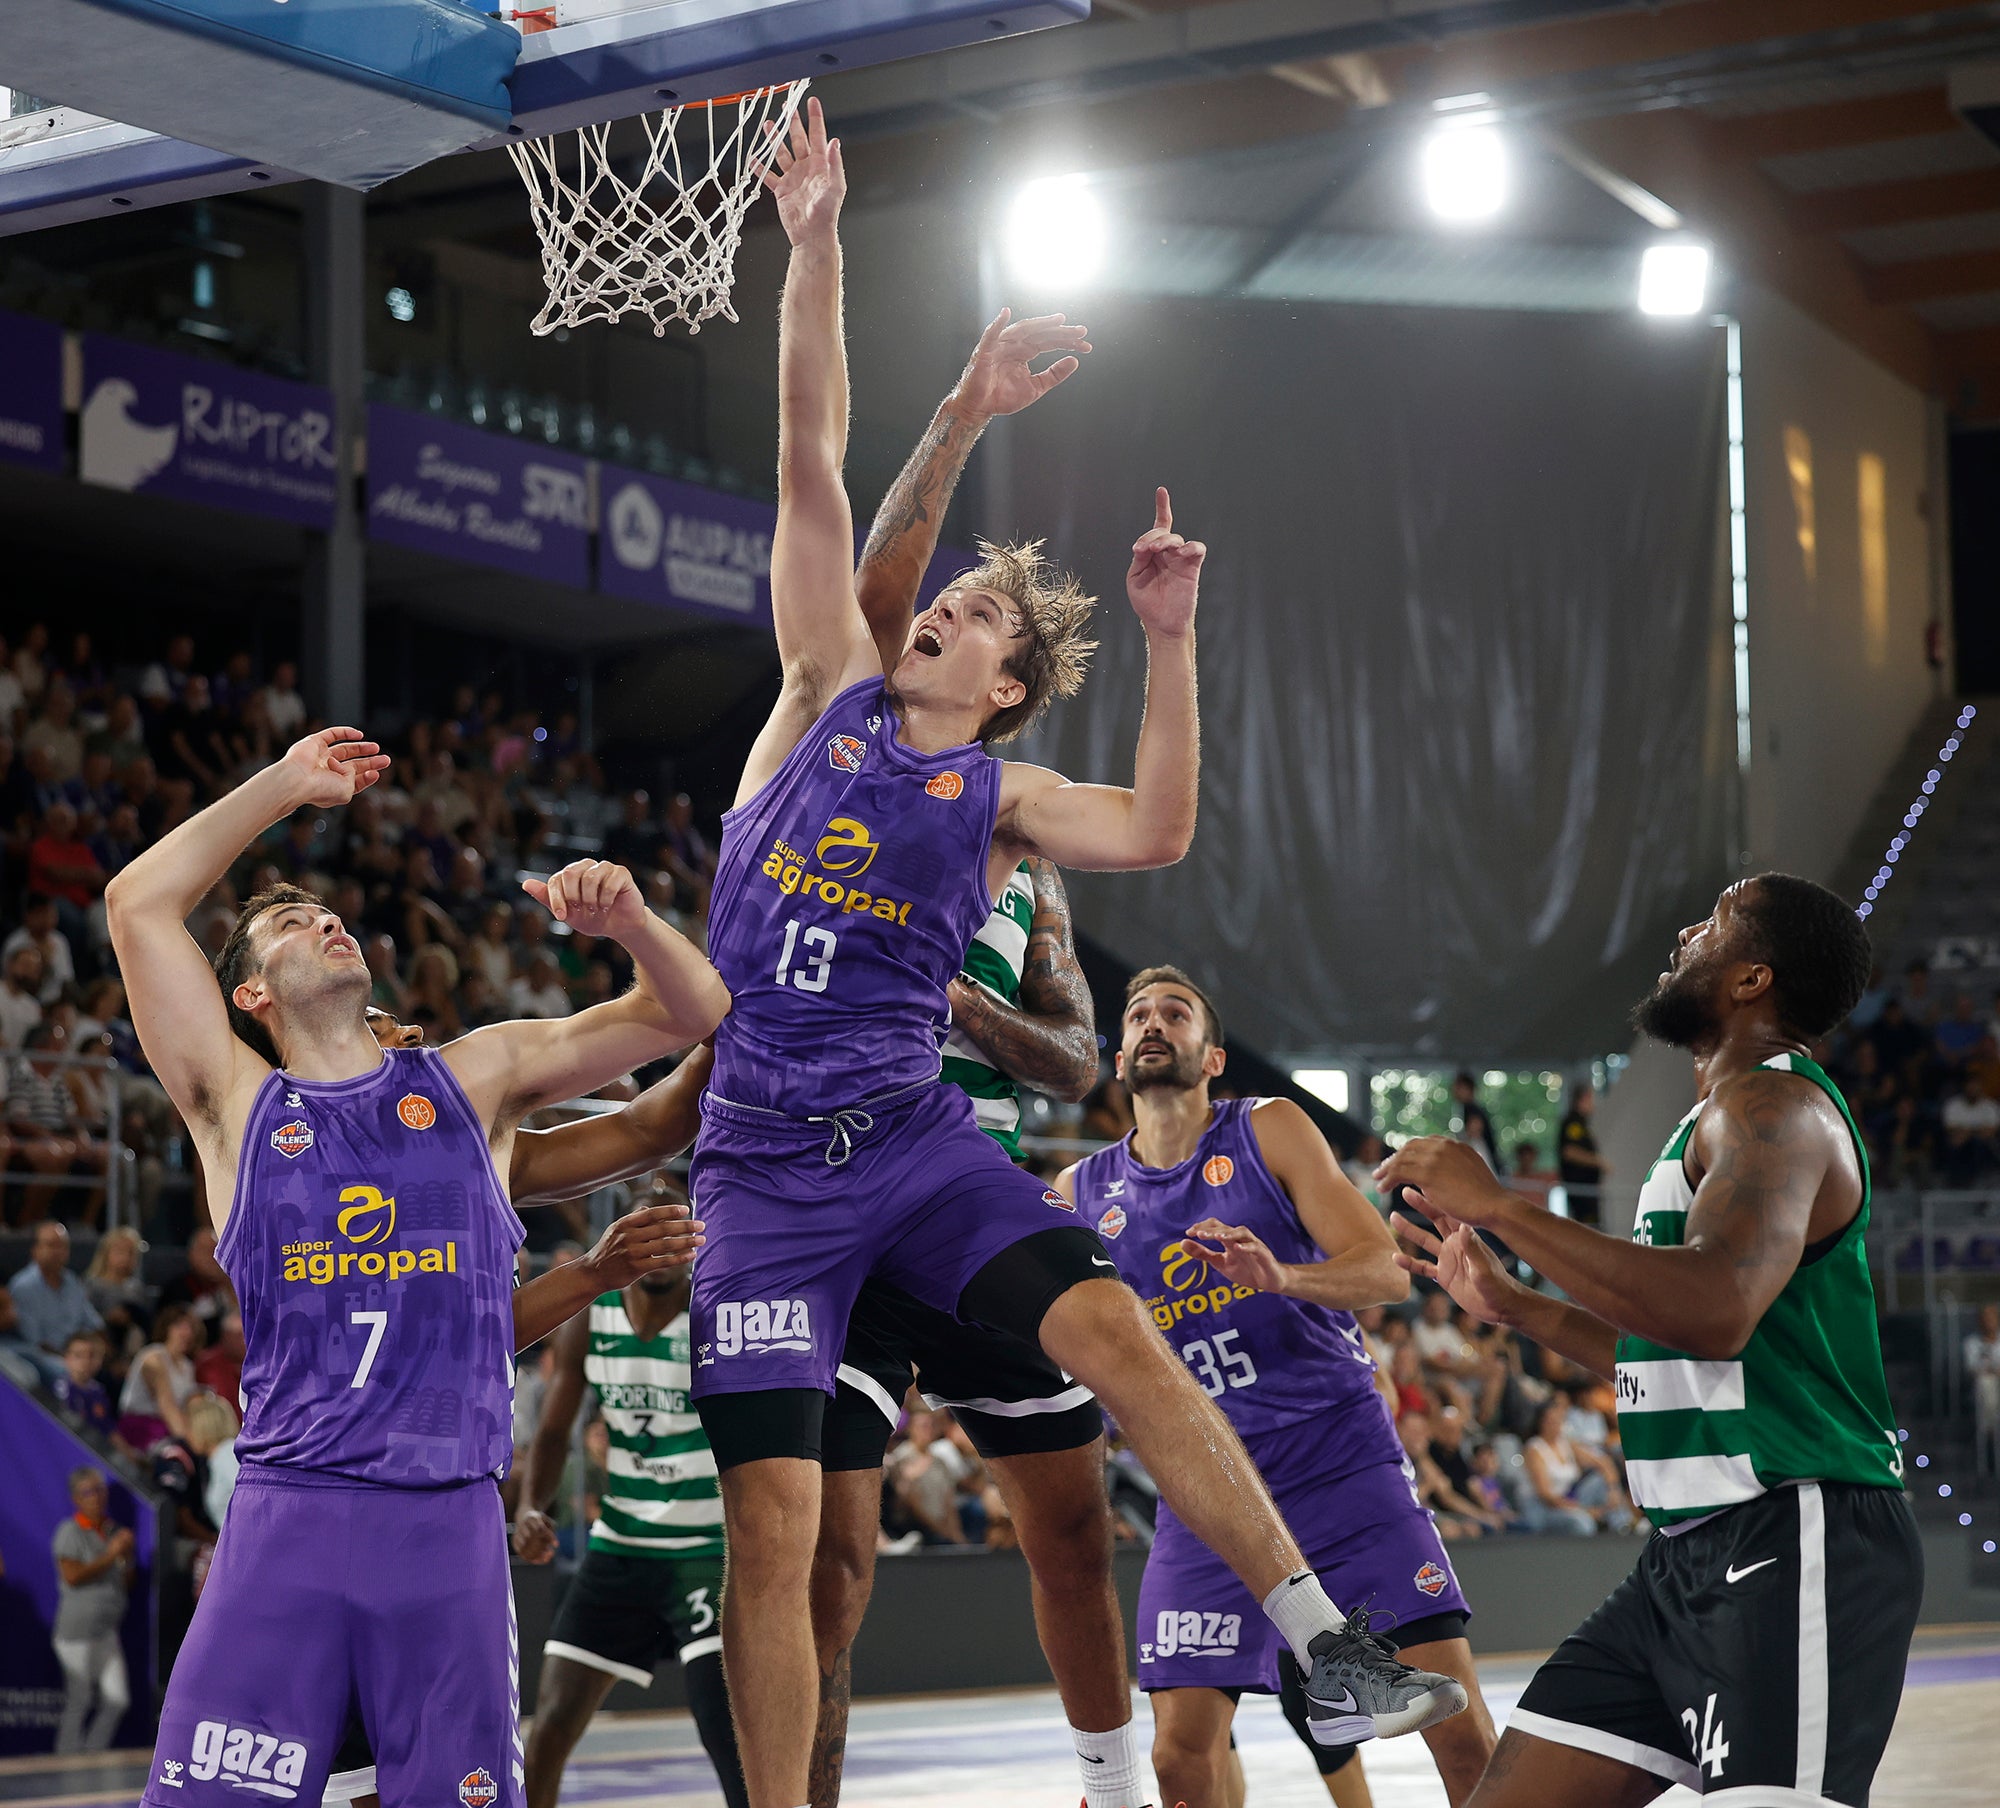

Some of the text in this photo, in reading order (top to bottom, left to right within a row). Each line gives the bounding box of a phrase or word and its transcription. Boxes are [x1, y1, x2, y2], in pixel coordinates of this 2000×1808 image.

[762, 852, 913, 927] agropal
[775, 919, 837, 993] 13
[274, 1135, 312, 1145] PALENCIA
[282, 1240, 333, 1256] súper
[283, 1242, 457, 1285] agropal
[350, 1310, 388, 1389] 7
[716, 1299, 812, 1356] gaza
[1182, 1328, 1257, 1399] 35
[599, 1384, 686, 1413] SPORTING
[632, 1413, 657, 1458] 3
[685, 1587, 715, 1635] 3
[1156, 1610, 1242, 1658] gaza
[189, 1720, 308, 1787] gaza
[159, 1775, 184, 1789] hummel
[461, 1785, 495, 1797] PALENCIA
